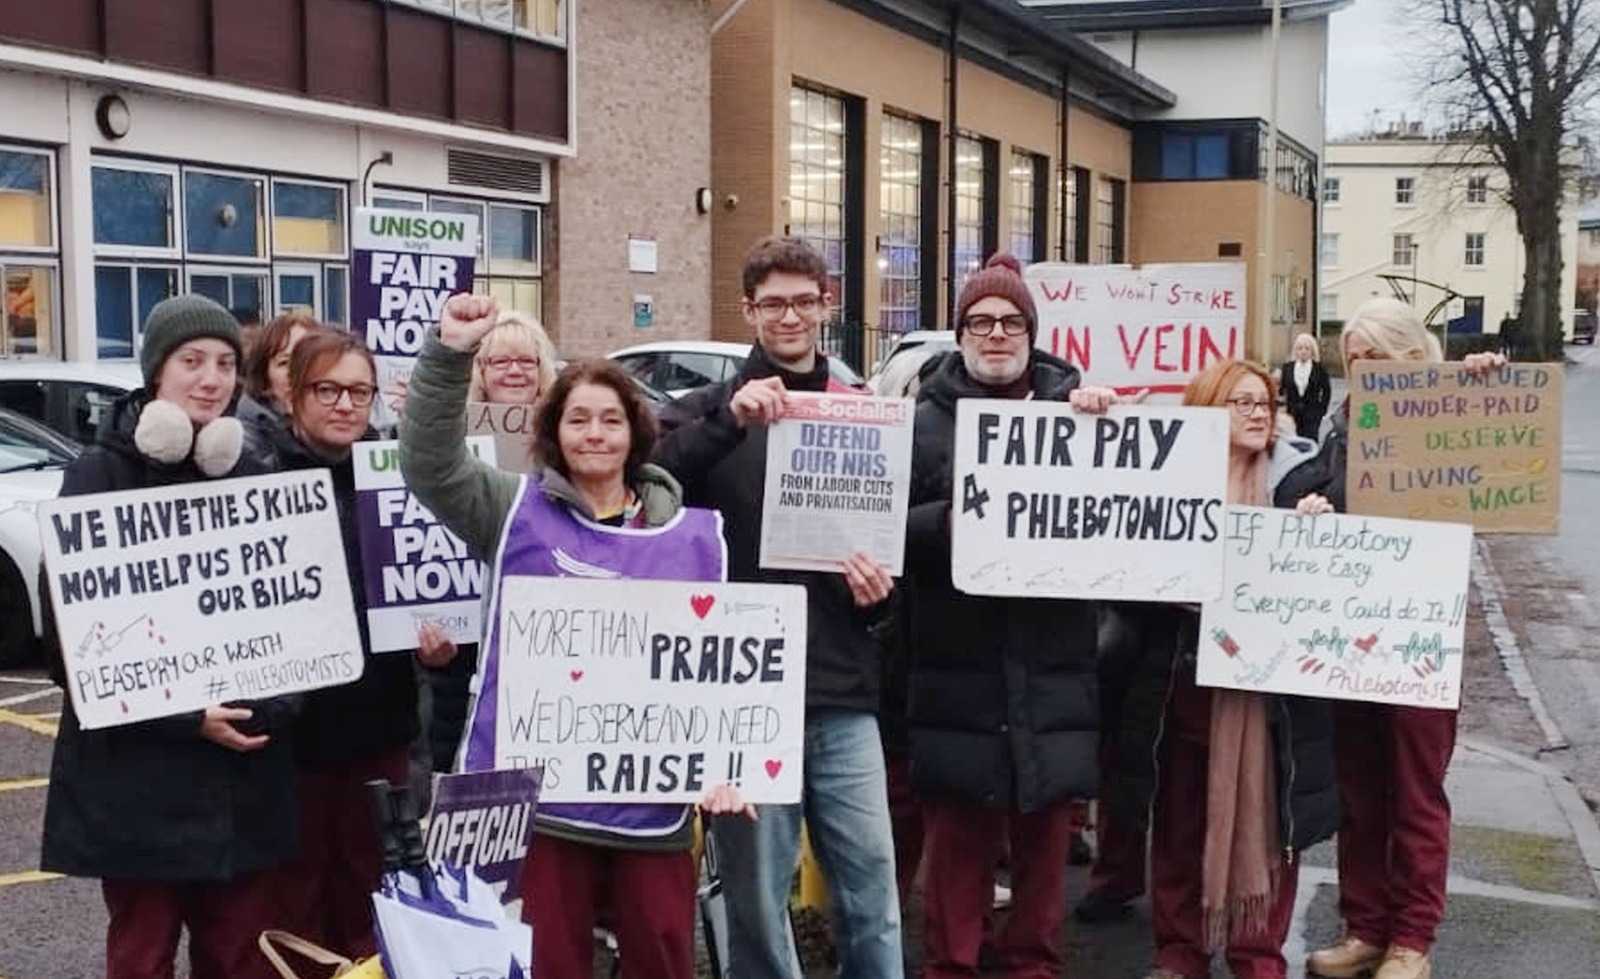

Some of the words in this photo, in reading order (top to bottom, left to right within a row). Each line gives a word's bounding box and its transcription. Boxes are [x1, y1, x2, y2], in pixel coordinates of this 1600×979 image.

[370, 215, 465, 241] UNISON
[370, 252, 458, 289] FAIR
[380, 287, 450, 321] PAY
[1040, 280, 1088, 302] WE
[366, 319, 427, 354] NO
[1051, 325, 1092, 373] IN
[1117, 324, 1237, 373] VEIN
[1393, 395, 1540, 418] UNDER-PAID
[801, 423, 881, 451] DEFEND
[977, 413, 1077, 467] FAIR
[1093, 416, 1184, 471] PAY
[1361, 436, 1398, 460] WE
[1426, 425, 1547, 451] DESERVE
[791, 449, 837, 475] OUR
[842, 453, 888, 478] NHS
[1359, 471, 1374, 490] A
[1390, 465, 1484, 493] LIVING
[779, 490, 804, 507] AND
[806, 492, 893, 514] PRIVATISATION
[780, 473, 814, 490] FROM
[816, 476, 861, 495] LABOUR
[863, 479, 894, 496] CUTS
[1469, 483, 1548, 512] WAGE
[51, 509, 107, 555] WE
[244, 480, 328, 524] SKILLS
[377, 490, 438, 527] FA
[962, 473, 990, 520] 4
[1007, 491, 1222, 543] PHLEBOTOMISTS
[393, 525, 468, 565] PAY
[1227, 511, 1265, 556] If
[1278, 512, 1411, 562] Phlebotomy
[59, 565, 122, 605] NOW
[126, 553, 193, 595] HELP
[199, 547, 230, 579] US
[240, 535, 288, 575] PAY
[382, 559, 481, 602] NOW
[1268, 553, 1320, 574] Were
[1327, 553, 1373, 588] Easy
[198, 585, 247, 616] OUR
[251, 565, 323, 609] BILLS
[1233, 583, 1332, 624] Everyone
[1343, 598, 1391, 620] Could
[1397, 598, 1419, 620] do
[507, 609, 584, 659] MORE
[588, 609, 648, 659] THAN
[650, 632, 785, 684] PRAISE
[77, 662, 147, 702] PLEASE
[182, 645, 218, 674] OUR
[224, 632, 283, 665] WORTH
[1325, 664, 1451, 702] Phlebotomist
[506, 684, 555, 744] WE
[718, 704, 780, 745] NEED
[586, 752, 705, 794] RAISE
[426, 802, 532, 872] OFFICIAL
